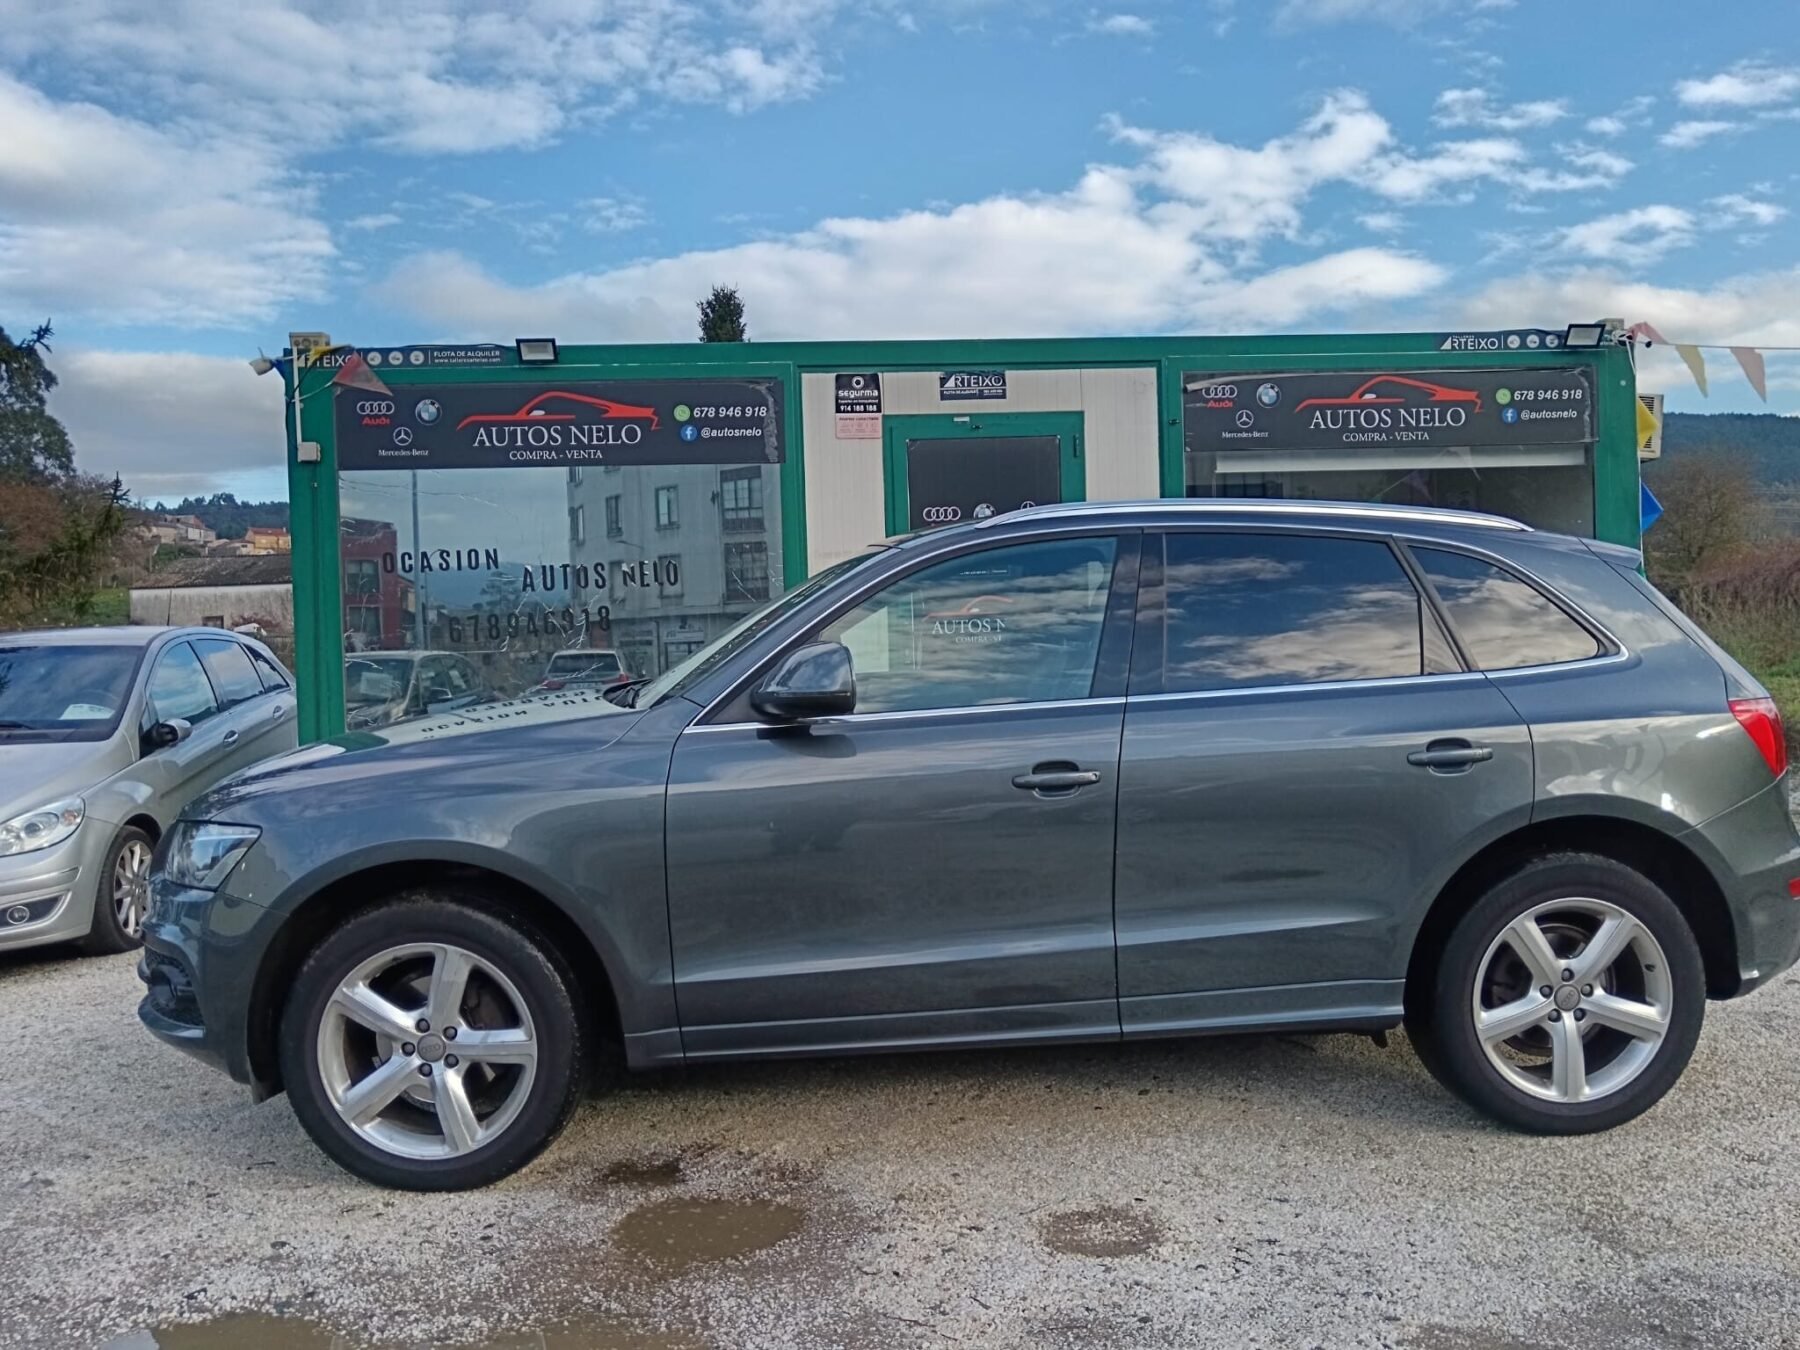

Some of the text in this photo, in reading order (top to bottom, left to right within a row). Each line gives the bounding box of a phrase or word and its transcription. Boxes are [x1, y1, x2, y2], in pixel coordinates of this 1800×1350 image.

[838, 390, 879, 399] segurma
[1513, 388, 1583, 400] 678 946 918
[840, 404, 851, 412] 914
[1207, 399, 1234, 408] Audi
[693, 405, 767, 418] 678 946 918
[1520, 408, 1578, 421] @autosnelo
[362, 416, 391, 426] Audi
[1309, 407, 1466, 429] AUTOS NELO
[473, 424, 642, 447] AUTOS NELO
[701, 426, 762, 439] @autosnelo
[1221, 430, 1269, 438] Mercedes-Benz
[1342, 432, 1387, 442] COMPRA
[1394, 431, 1430, 441] VENTA
[378, 448, 429, 457] Mercedes-Benz
[509, 450, 557, 461] COMPRA
[565, 449, 603, 460] VENTA
[382, 548, 499, 574] OCASION
[522, 560, 679, 593] AUTOS NELO
[450, 605, 611, 643] 678946918
[932, 618, 991, 635] AUTOS
